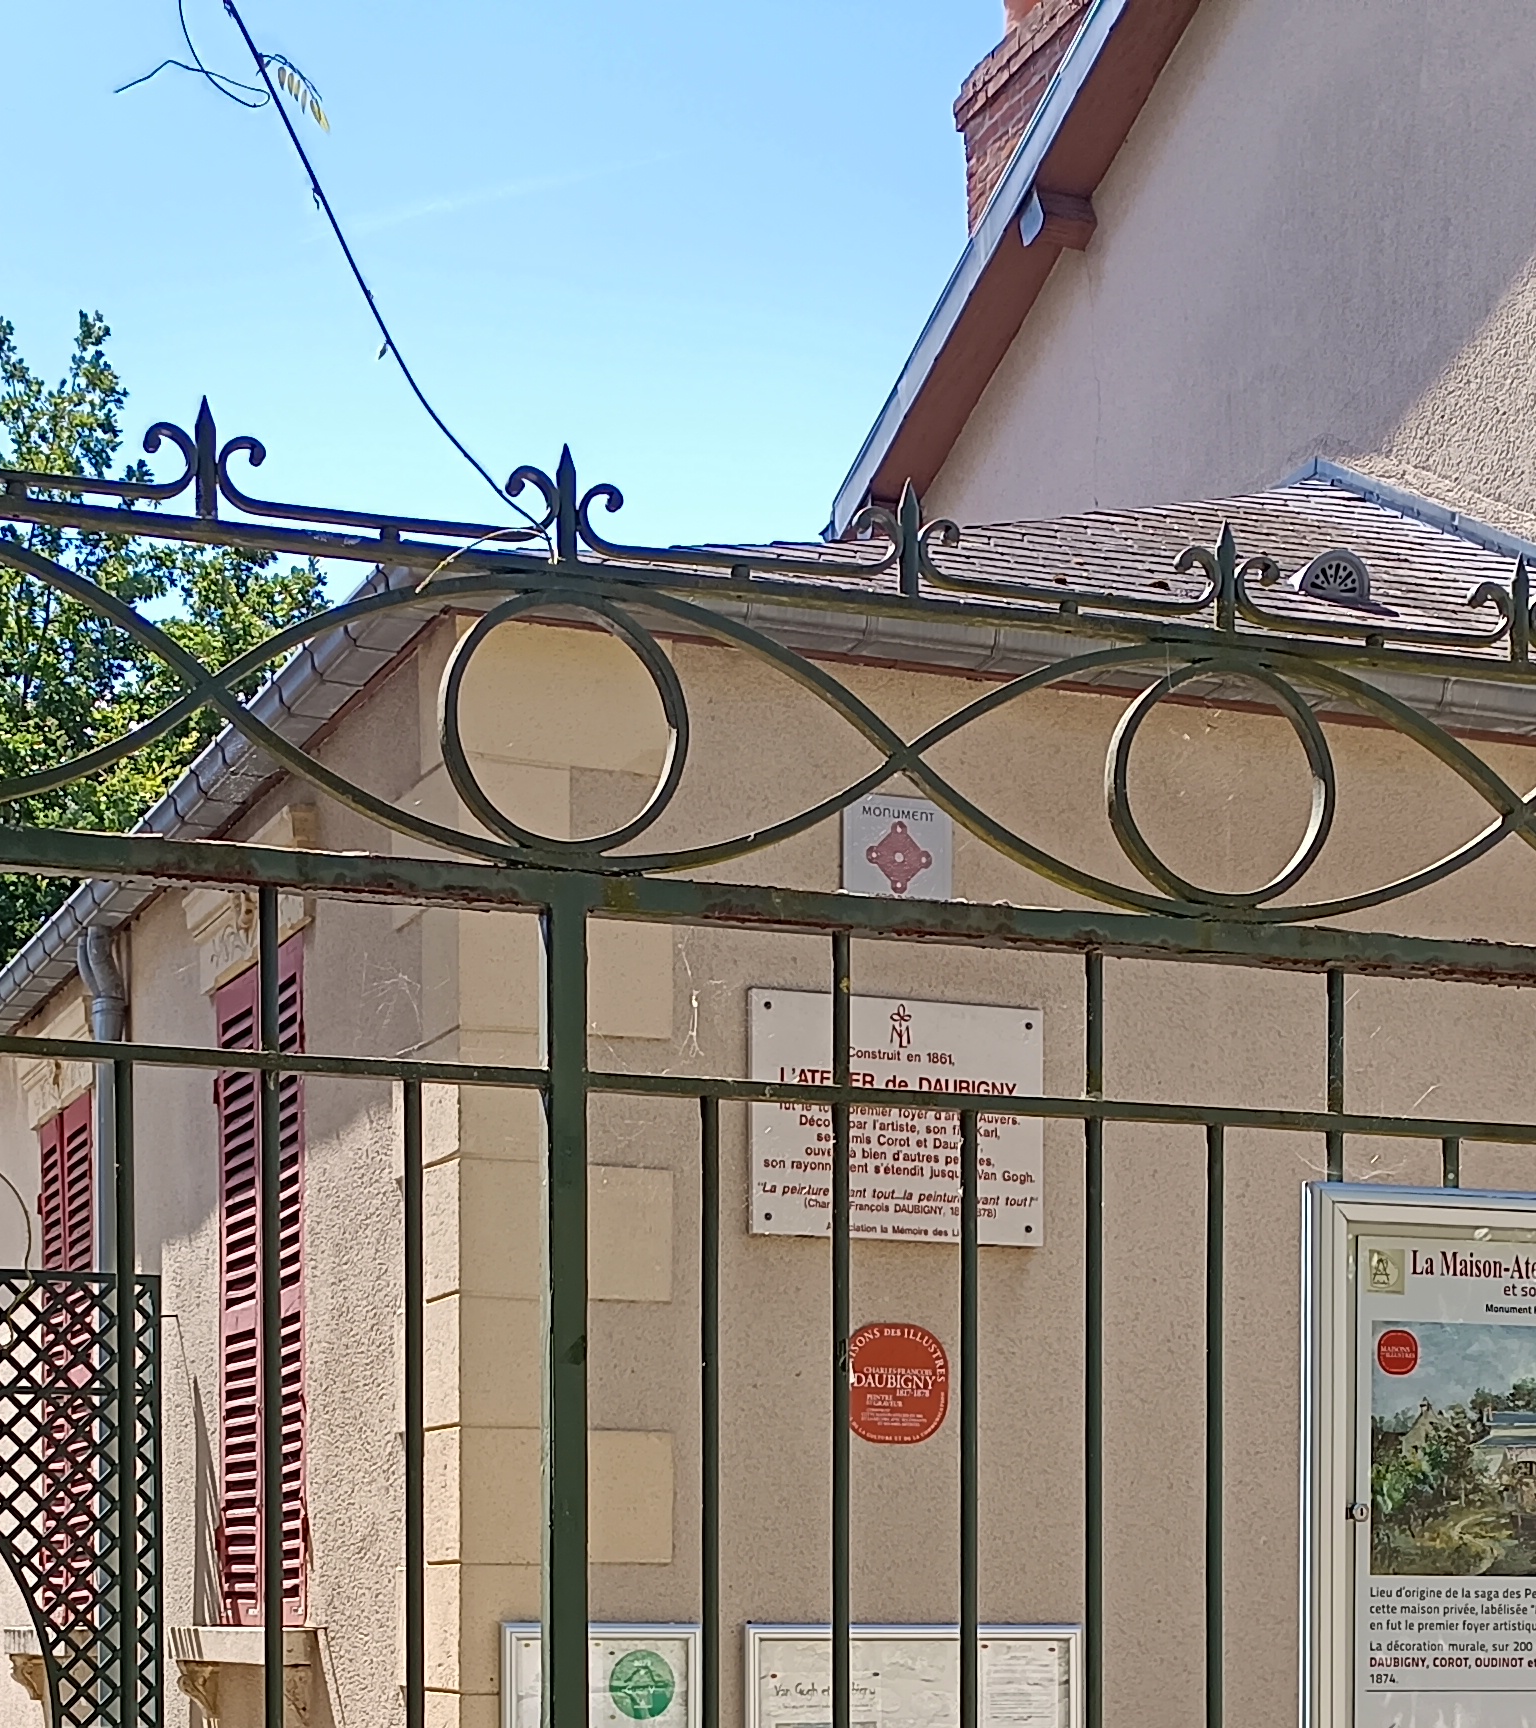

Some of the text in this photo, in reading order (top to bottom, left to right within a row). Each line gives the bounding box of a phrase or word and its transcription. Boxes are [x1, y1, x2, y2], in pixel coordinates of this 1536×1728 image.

[862, 806, 934, 821] MONUMENT
[849, 1046, 955, 1066] Construit en 1861,
[780, 1067, 1017, 1095] L'ATEER de DAUBIGNY
[799, 1115, 840, 1128] Déco
[849, 1120, 868, 1132] par
[873, 1119, 920, 1135] l'artiste,
[925, 1125, 947, 1136] son
[978, 1114, 1021, 1126] Auvers.
[816, 1132, 834, 1143] se
[849, 1134, 872, 1145] mis
[877, 1134, 911, 1148] Corot
[916, 1138, 928, 1149] et
[805, 1146, 839, 1157] ouve
[862, 1147, 887, 1161] bien
[892, 1150, 939, 1163] d'autres
[764, 1158, 785, 1169] son
[791, 1159, 868, 1174] rayonnent
[874, 1163, 924, 1177] s'étendit
[977, 1170, 997, 1181] Van
[1002, 1170, 1035, 1185] Gogh.
[782, 1183, 830, 1197] peinture
[974, 1195, 1000, 1206] vant
[894, 1203, 946, 1217] DAUBIGNY,
[881, 1224, 888, 1234] la
[892, 1225, 929, 1237] Mémoire
[932, 1227, 949, 1237] des
[1411, 1249, 1434, 1276] La
[1503, 1283, 1518, 1297] et
[1485, 1303, 1532, 1315] Monument
[884, 1328, 901, 1337] DES
[904, 1327, 945, 1383] ILLUSTRES
[853, 1373, 935, 1390] DAUBIGNY
[1370, 1586, 1393, 1598] Lieu
[1396, 1586, 1443, 1601] d'origine
[1445, 1588, 1462, 1598] de
[1462, 1588, 1471, 1598] la
[1474, 1589, 1499, 1601] saga
[1502, 1588, 1521, 1599] des
[1369, 1604, 1397, 1615] cette
[1400, 1604, 1440, 1615] maison
[1443, 1604, 1479, 1617] privée,
[1481, 1604, 1528, 1615] labélisée
[1369, 1621, 1383, 1631] en
[1386, 1619, 1402, 1631] fut
[1405, 1620, 1414, 1631] le
[1417, 1620, 1459, 1633] premier
[1462, 1620, 1490, 1633] foyer
[1369, 1640, 1382, 1651] La
[1386, 1640, 1444, 1652] décoration
[1448, 1641, 1489, 1653] murale,
[1492, 1643, 1510, 1652] sur
[1513, 1641, 1533, 1652] 200
[1369, 1656, 1430, 1669] DAUBIGNY,
[1433, 1657, 1472, 1670] COROT,
[1475, 1657, 1524, 1668] OUDINOT
[1369, 1673, 1399, 1685] 1874.
